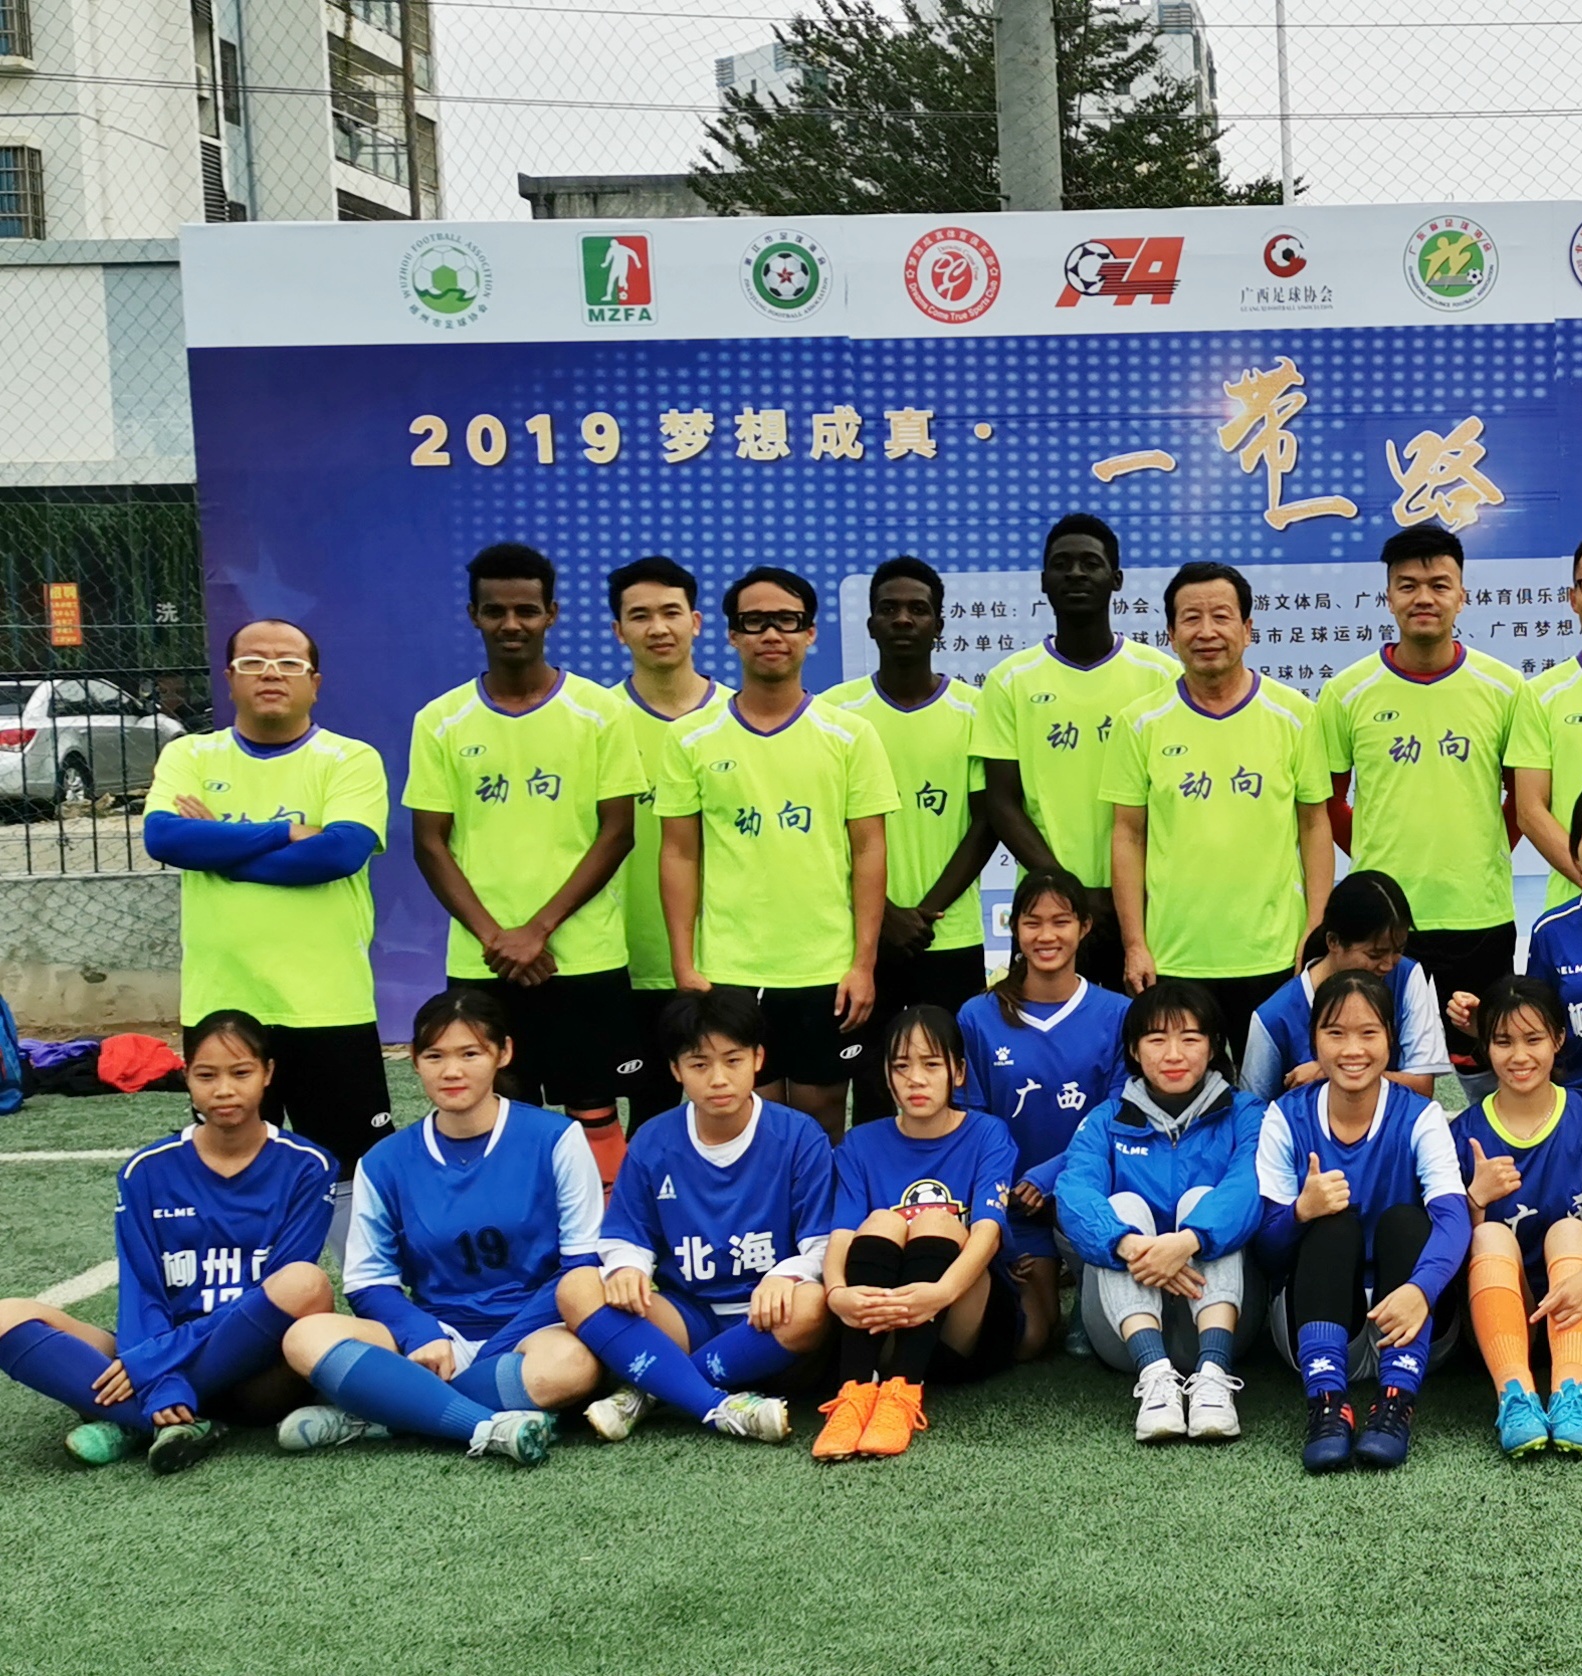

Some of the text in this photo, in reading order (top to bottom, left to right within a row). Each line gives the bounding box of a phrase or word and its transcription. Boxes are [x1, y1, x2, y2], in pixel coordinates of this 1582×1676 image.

[399, 251, 414, 299] WUZHOU
[411, 232, 463, 253] FOOTBALL
[588, 307, 652, 322] MZFA
[907, 279, 999, 322] Dreams Come True Sports Club
[1240, 285, 1334, 304] 广西足球协会
[408, 411, 621, 466] 2019
[1091, 355, 1505, 534] 一带一路
[1389, 728, 1472, 768] 动向
[476, 766, 562, 804] 动向
[1178, 764, 1264, 803] 动向
[735, 799, 813, 838] 动向
[1012, 1078, 1088, 1119] 广西
[1114, 1140, 1150, 1157] ELME
[454, 1225, 510, 1277] 19
[674, 1230, 777, 1283] 北海
